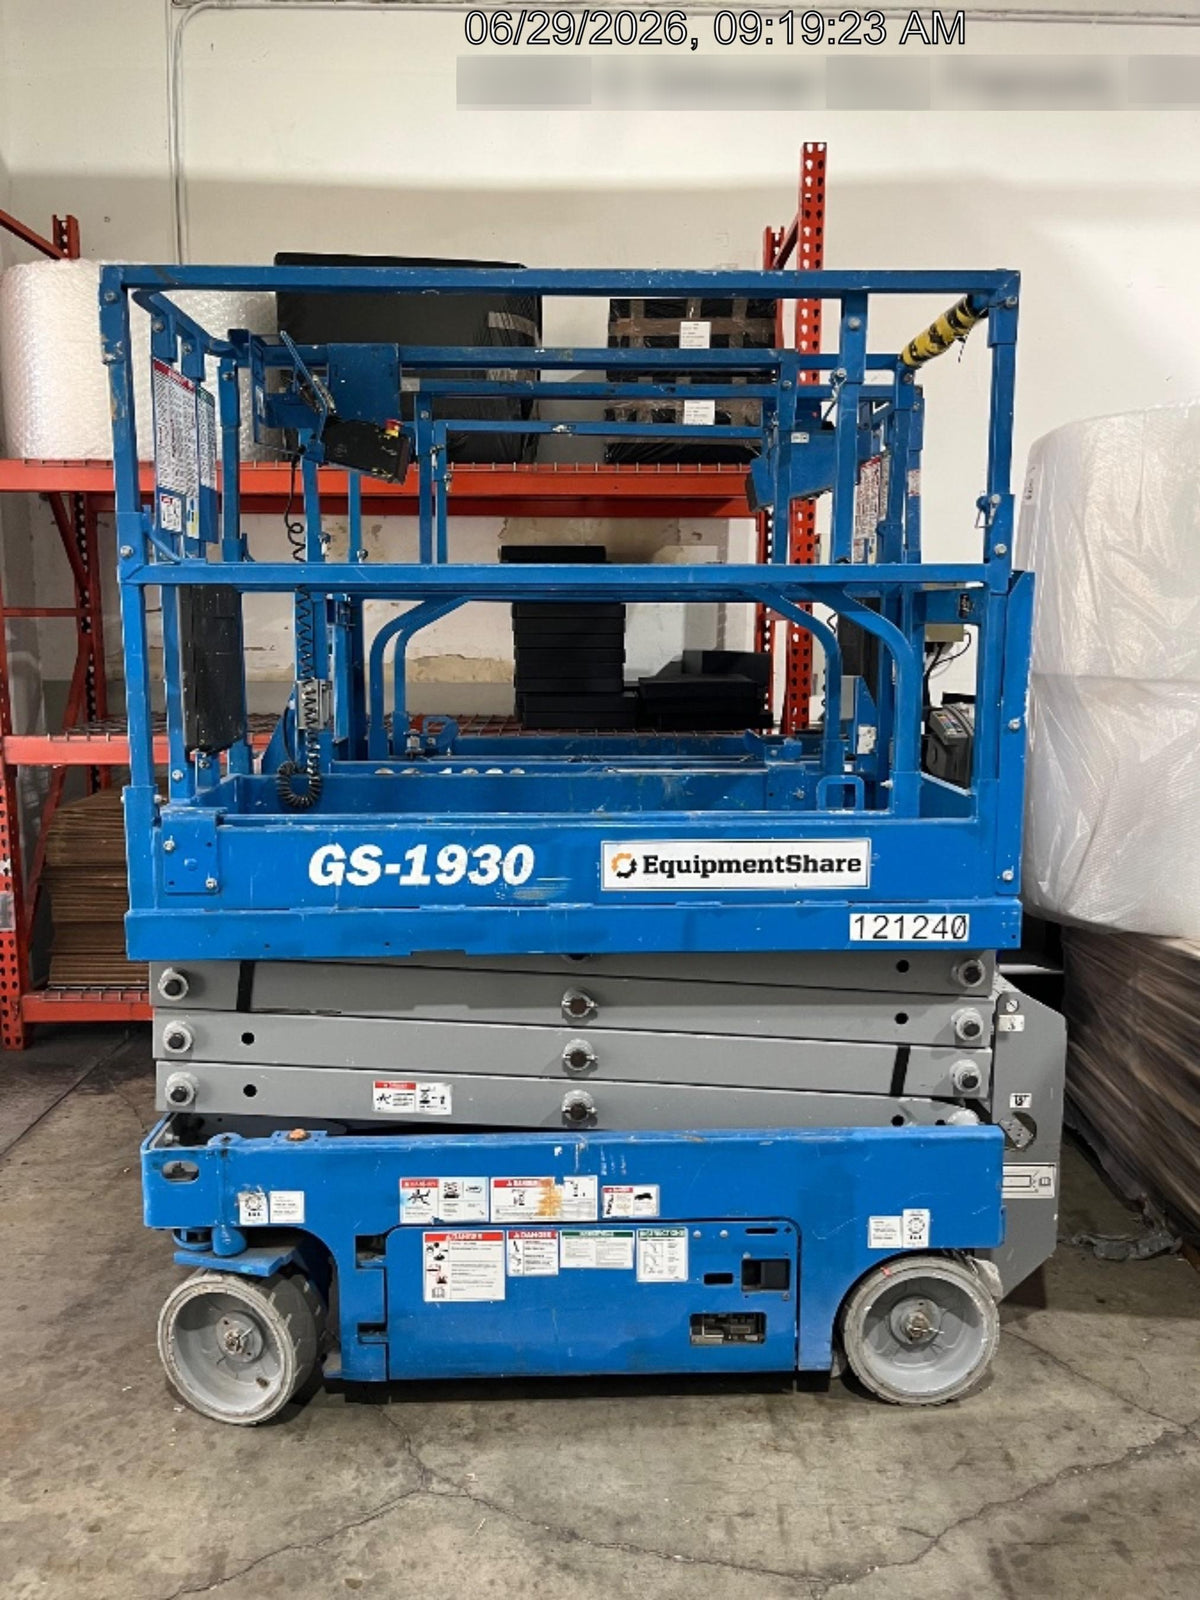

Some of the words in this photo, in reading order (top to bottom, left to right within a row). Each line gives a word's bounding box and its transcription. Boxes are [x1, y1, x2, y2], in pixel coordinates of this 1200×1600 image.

[308, 842, 535, 886] GS-1930
[643, 854, 862, 878] EquipmentShare
[854, 915, 967, 939] 121240
